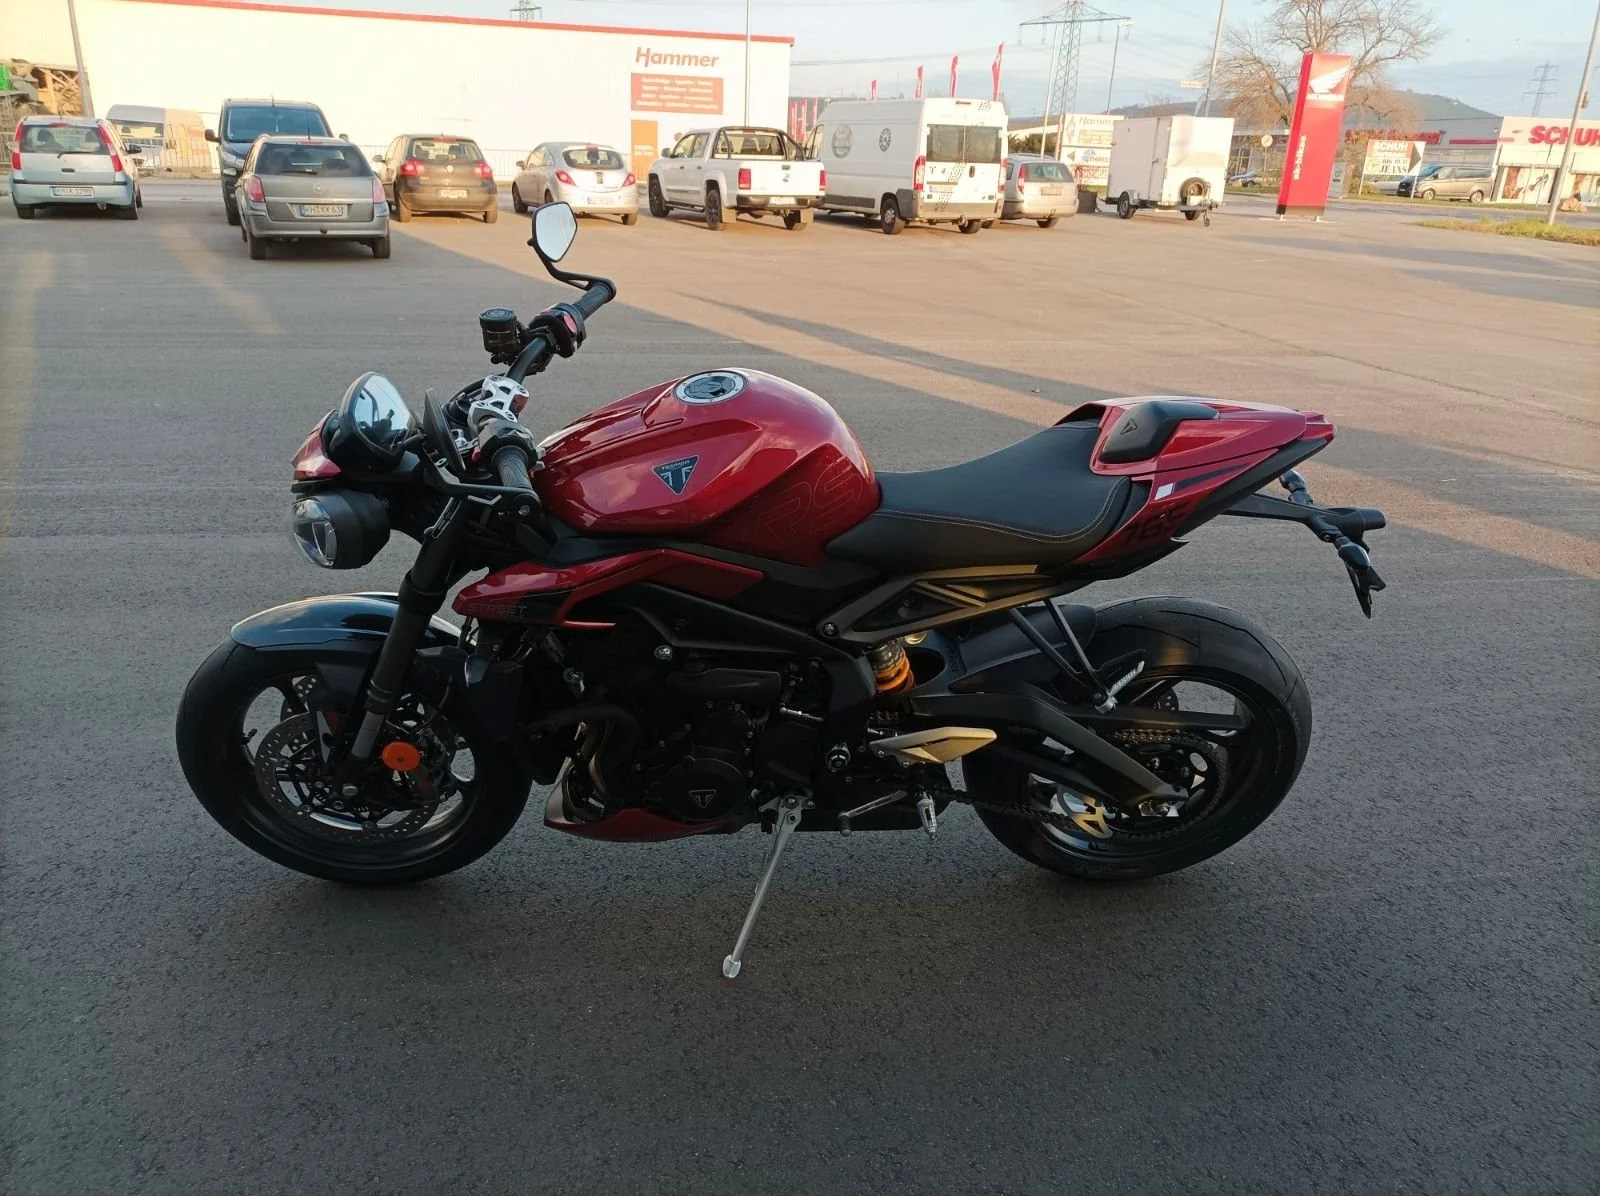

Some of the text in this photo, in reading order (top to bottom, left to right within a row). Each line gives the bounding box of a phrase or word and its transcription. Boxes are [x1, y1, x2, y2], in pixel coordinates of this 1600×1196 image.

[635, 46, 719, 68] Hammer
[661, 460, 690, 471] TRIUMPH
[746, 455, 865, 546] RS
[467, 602, 528, 614] STREET
